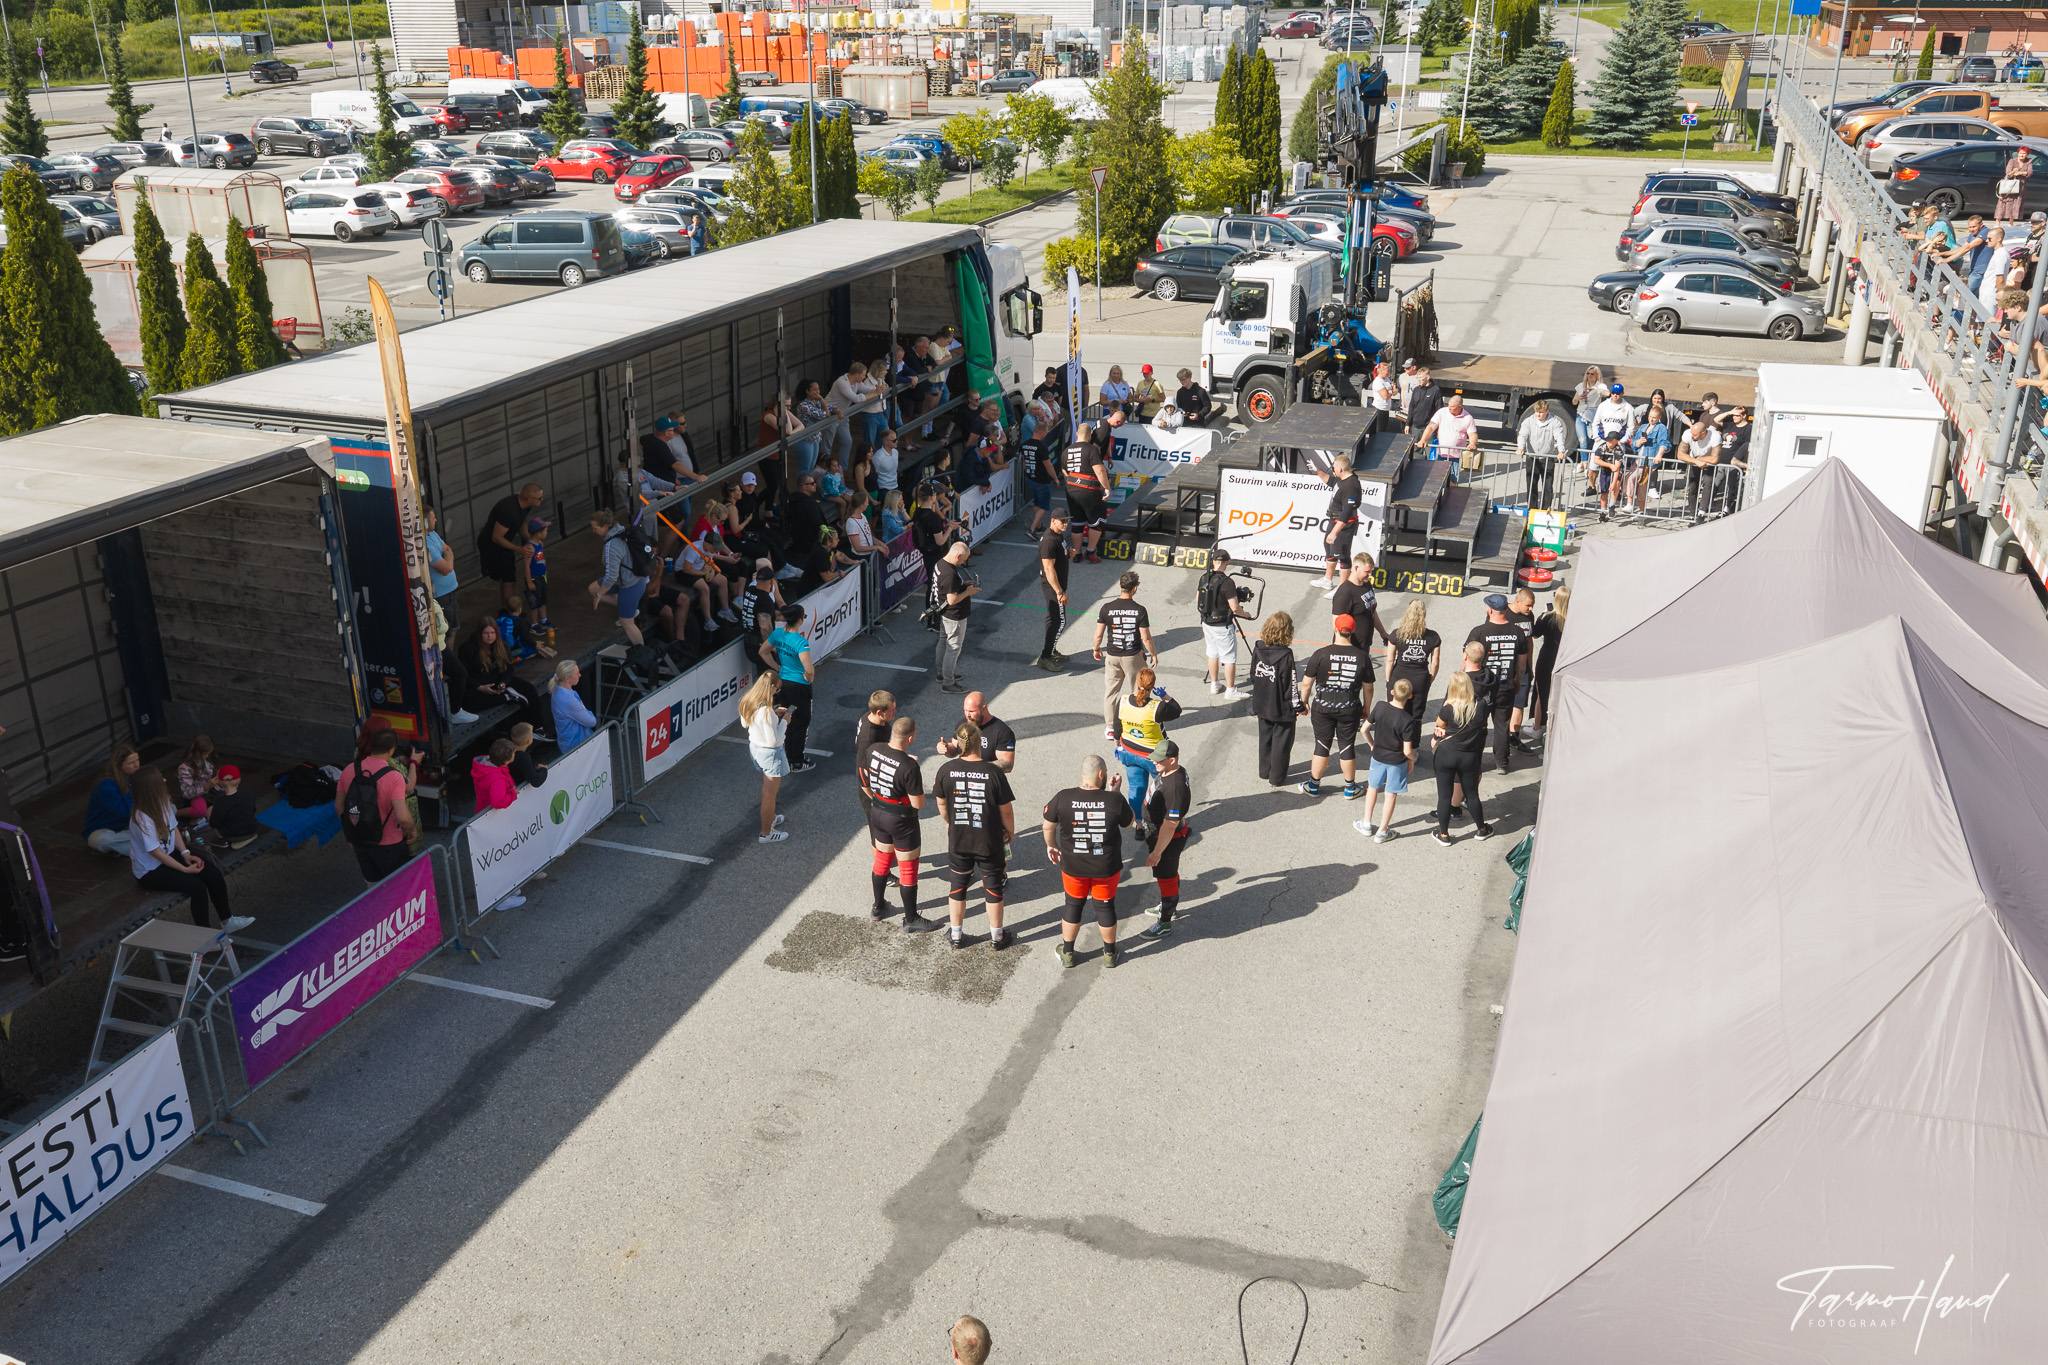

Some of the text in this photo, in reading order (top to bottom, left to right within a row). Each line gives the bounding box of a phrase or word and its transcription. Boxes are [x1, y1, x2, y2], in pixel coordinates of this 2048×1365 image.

[351, 104, 367, 112] Drive
[1235, 323, 1252, 331] 5560
[1228, 474, 1263, 487] Suurim
[1265, 479, 1288, 489] valik
[972, 483, 1013, 529] KASTELLI
[1228, 509, 1274, 527] POP
[1103, 539, 1130, 560] 150
[1142, 545, 1168, 566] 175
[1174, 547, 1209, 569] 200
[1425, 573, 1463, 596] 200
[814, 590, 859, 641] SPORT!
[649, 722, 668, 750] 24
[672, 713, 680, 733] 7
[949, 770, 990, 780] DINS OZOLS
[1071, 800, 1105, 809] ZUKULIS
[476, 771, 608, 872] Woodwell Grupp
[302, 889, 427, 1003] KLEEBIKUM
[374, 920, 423, 960] REKLAAM
[0, 1087, 120, 1212] ESTI
